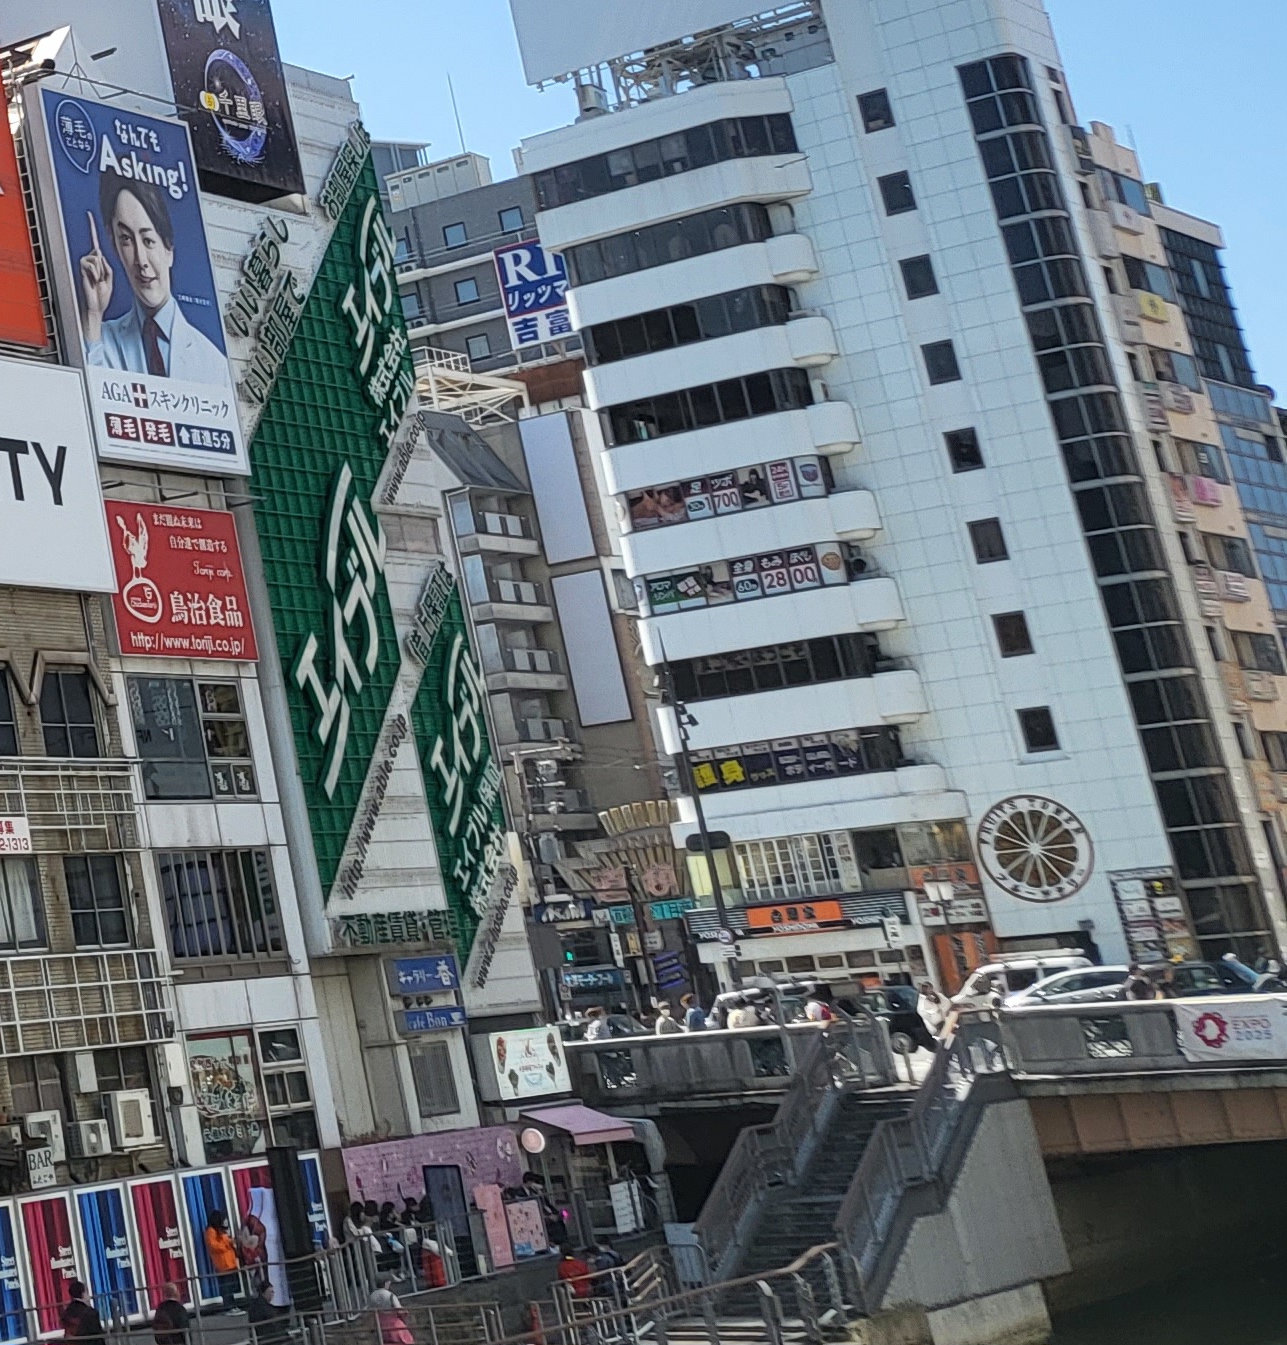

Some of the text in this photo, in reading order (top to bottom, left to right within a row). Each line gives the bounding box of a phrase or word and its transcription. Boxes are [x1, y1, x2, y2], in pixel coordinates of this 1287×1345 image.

[99, 134, 189, 200] Asking!
[229, 216, 289, 338] いい暮らし
[245, 269, 306, 405] いい部屋で
[368, 324, 409, 409] 株式会社
[512, 309, 574, 346] 吉富
[101, 381, 229, 418] AGA スキンクリニック
[378, 368, 414, 450] エイブル
[385, 409, 427, 507] www.able.co.jp
[169, 590, 244, 628] 鳥治食品
[294, 460, 387, 803] エイブル
[343, 712, 408, 901] http://www.able.co.jp
[28, 1145, 55, 1172] BAR
